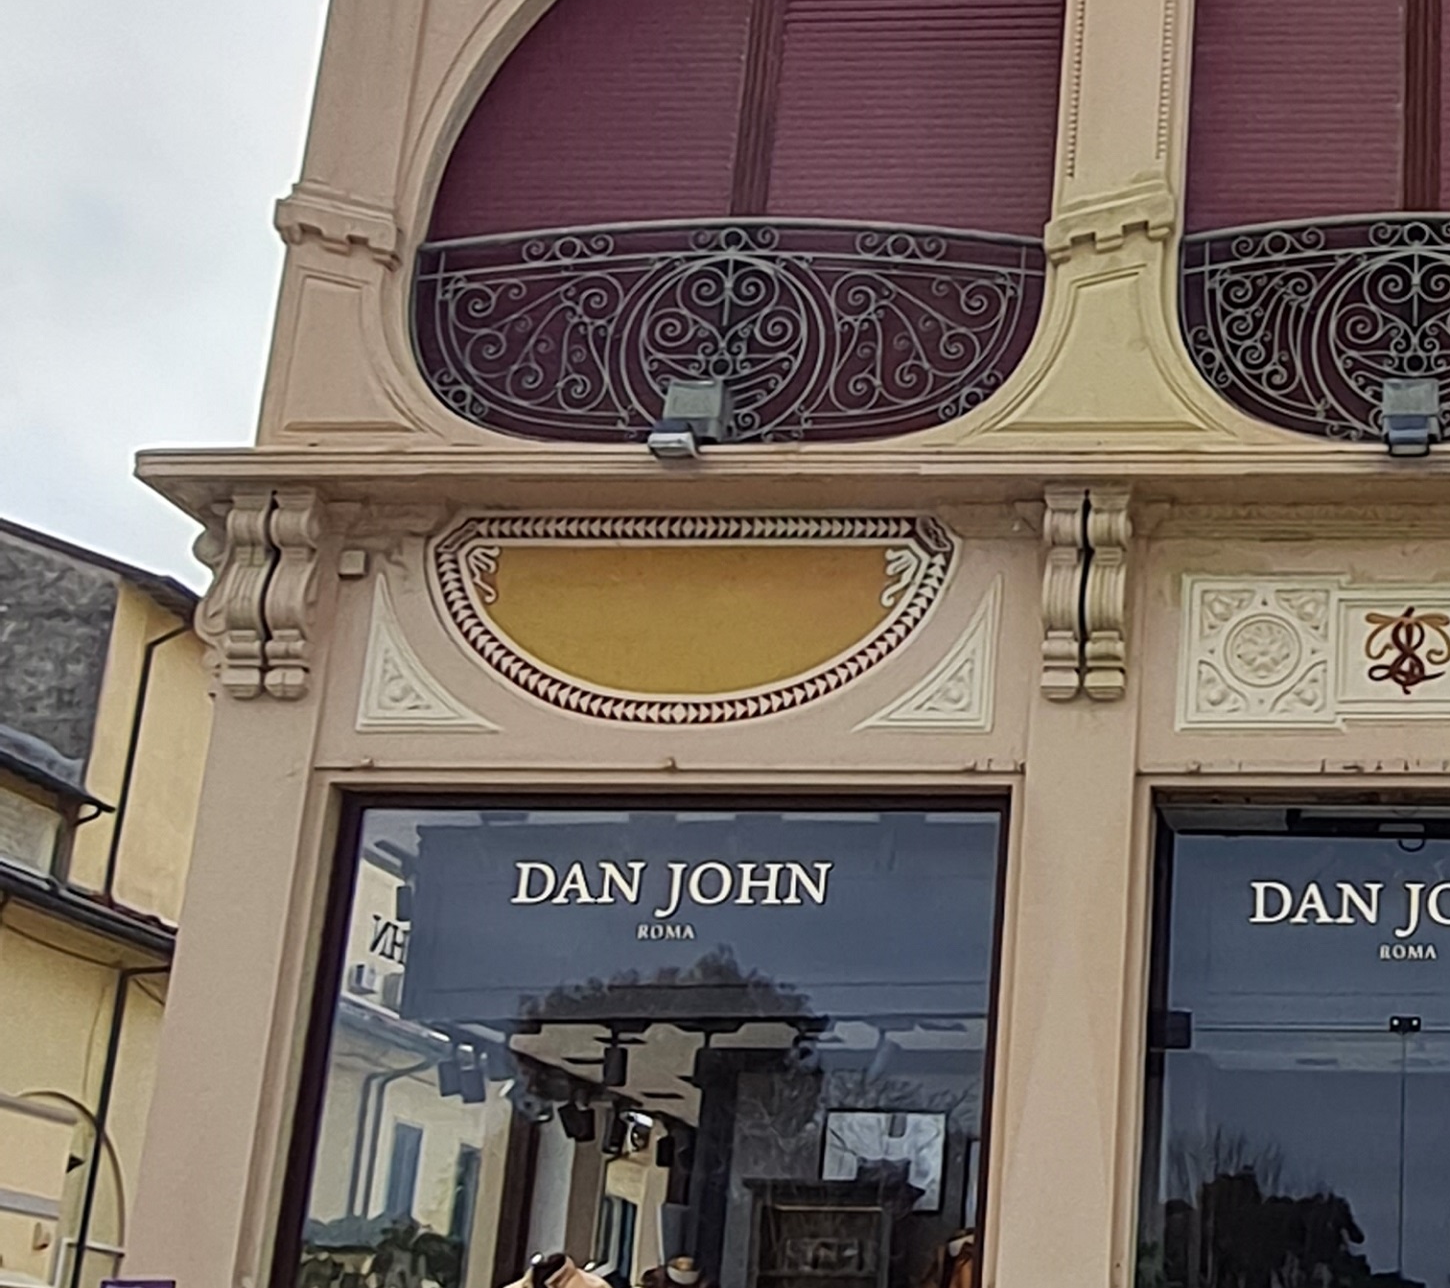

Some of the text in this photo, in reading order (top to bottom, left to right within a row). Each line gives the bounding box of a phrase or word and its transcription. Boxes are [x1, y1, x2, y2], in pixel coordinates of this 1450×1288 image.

[511, 862, 833, 918] DAN JOHN
[1249, 881, 1384, 925] DAN
[637, 924, 695, 940] ROMA
[1379, 944, 1438, 960] ROMA
